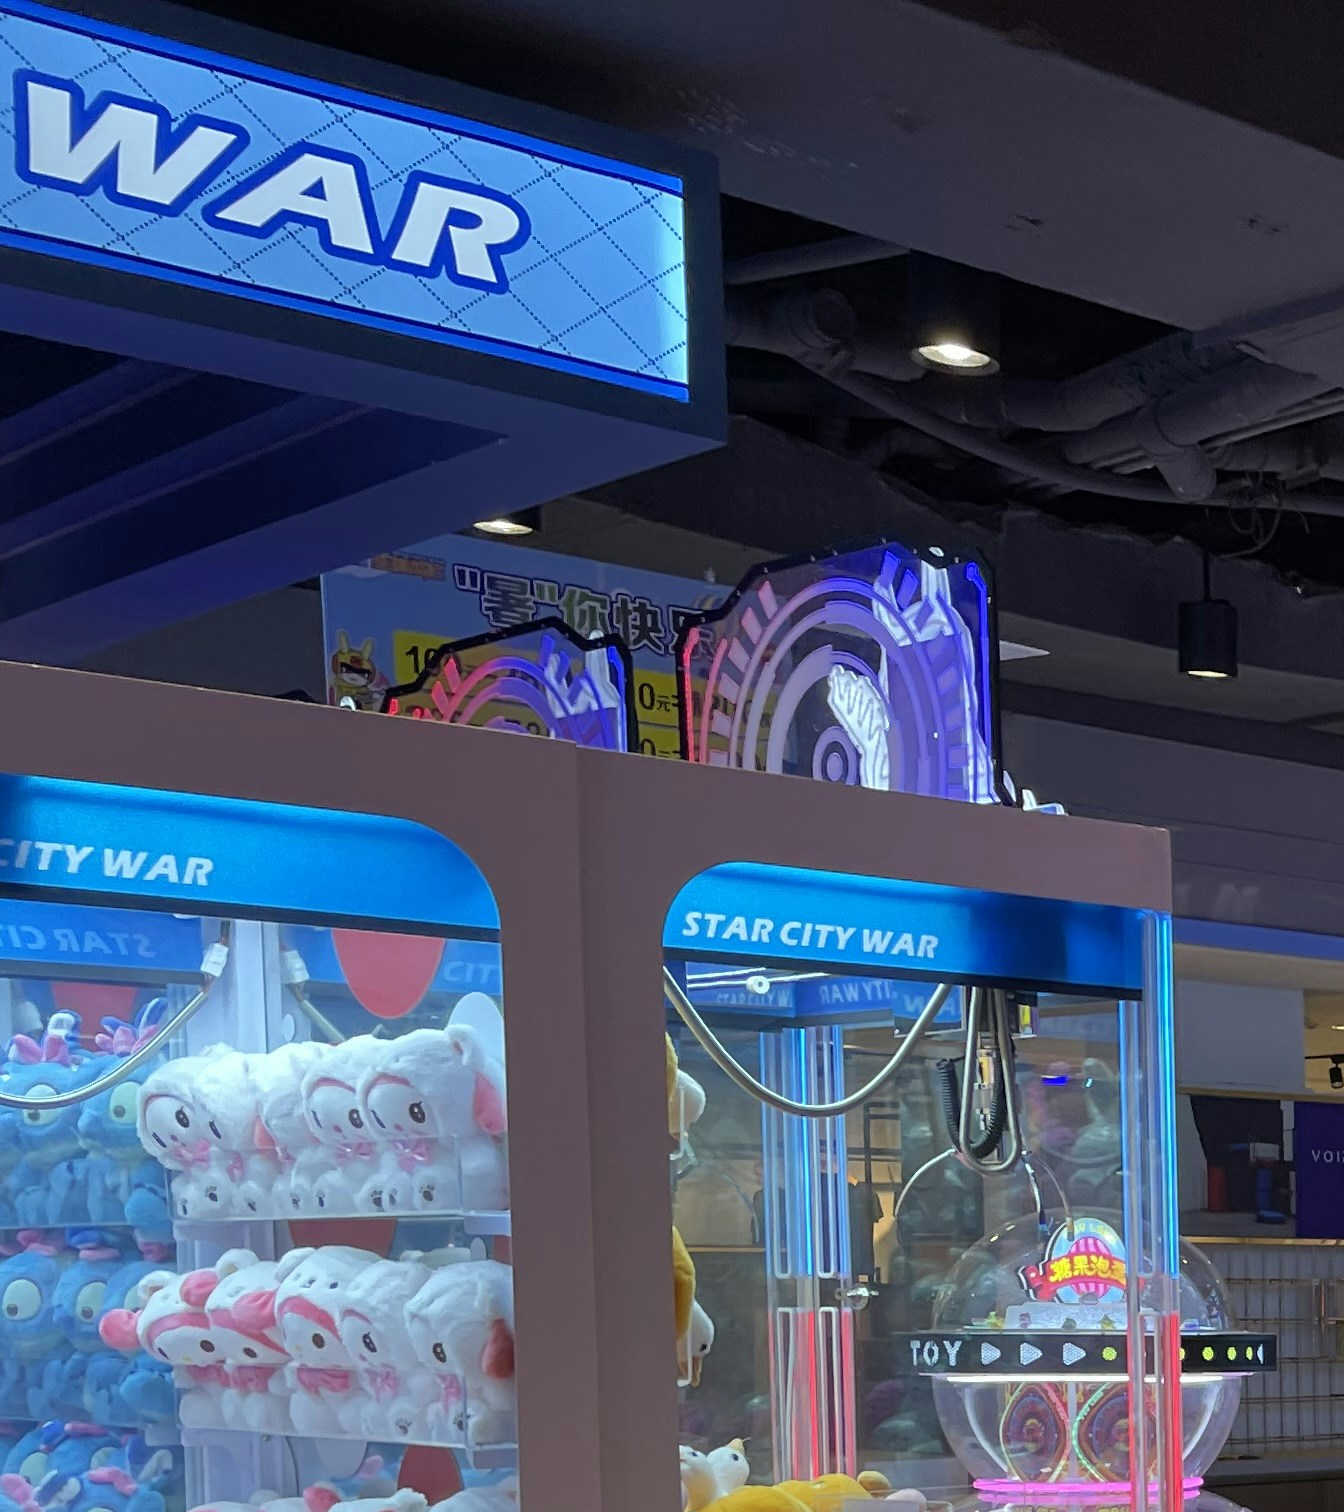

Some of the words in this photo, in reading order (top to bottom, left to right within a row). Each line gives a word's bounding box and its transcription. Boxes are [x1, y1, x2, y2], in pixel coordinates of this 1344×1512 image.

[20, 75, 527, 289] WAR
[103, 848, 214, 886] WAR
[682, 912, 774, 943] STAR
[781, 921, 856, 950] CITY
[862, 929, 938, 958] WAR
[910, 1340, 962, 1366] TOY
